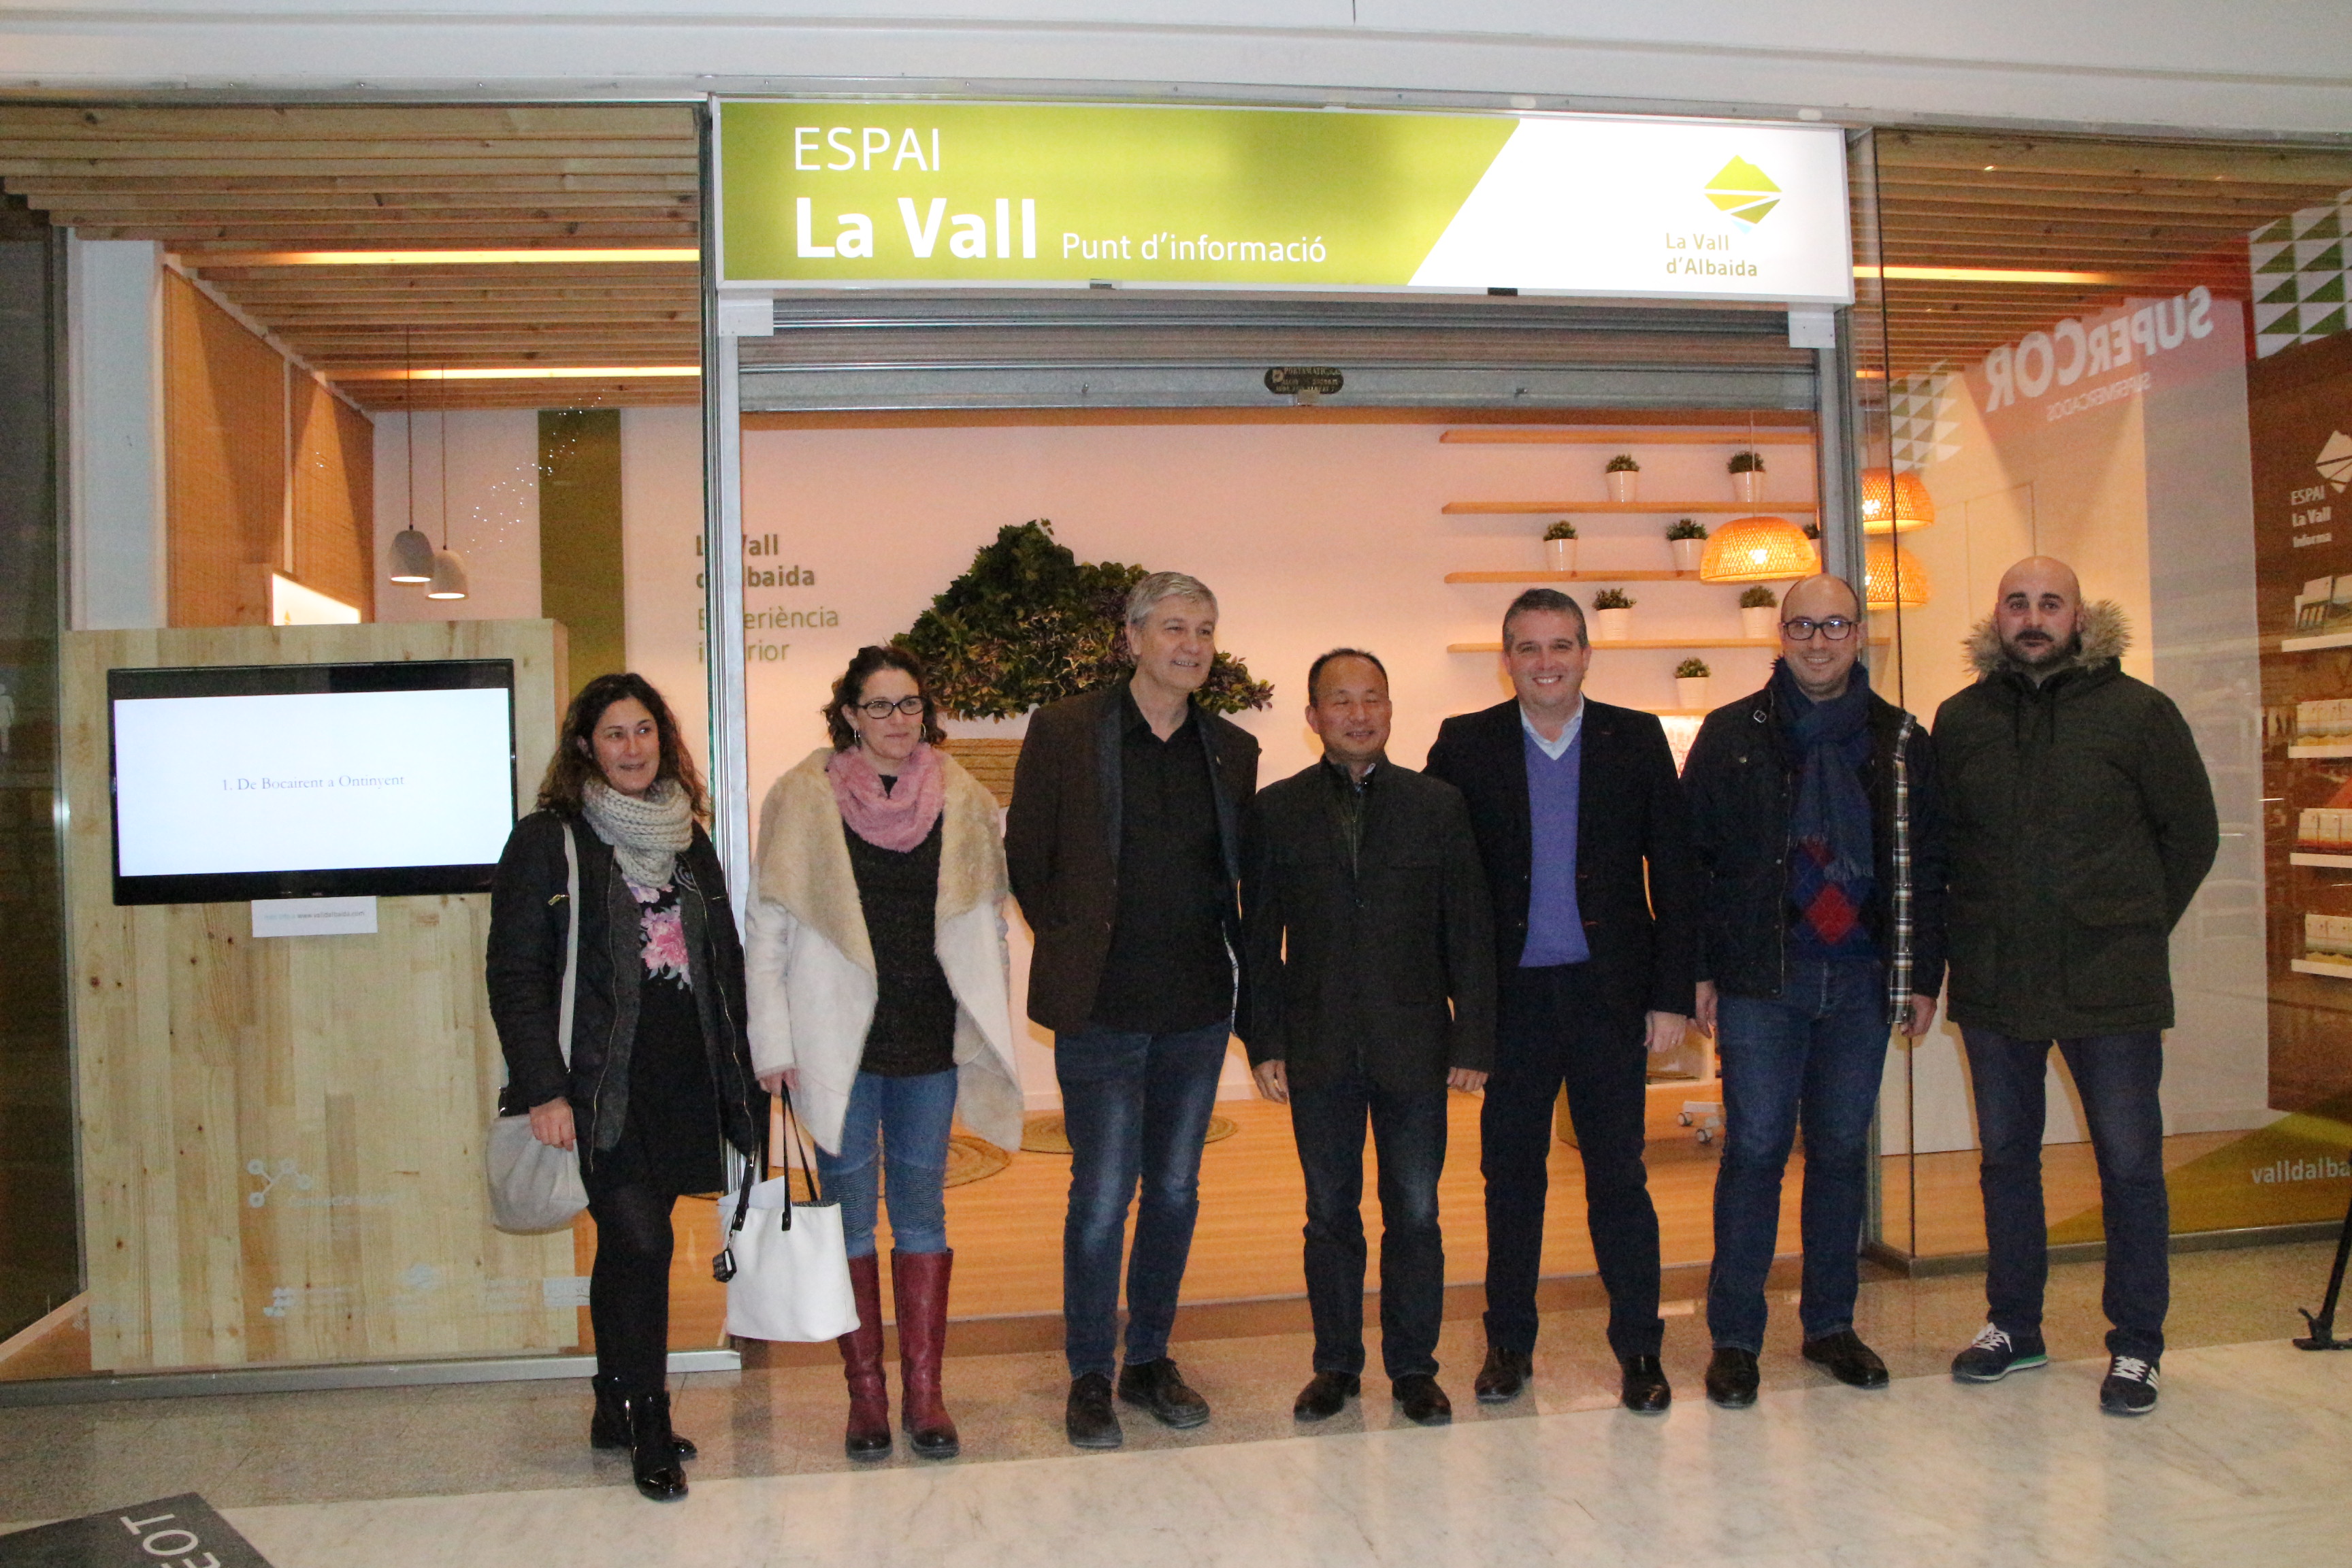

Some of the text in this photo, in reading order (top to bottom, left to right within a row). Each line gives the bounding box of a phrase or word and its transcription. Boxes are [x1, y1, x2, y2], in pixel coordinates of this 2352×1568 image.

[794, 127, 941, 171] ESPAI
[796, 197, 1327, 263] La Vall Punt d'informació
[1665, 233, 1729, 250] La Vall
[1666, 257, 1758, 277] d'Albaida
[2291, 485, 2325, 506] ESPAI
[2292, 506, 2332, 527] La Vall
[223, 774, 405, 791] 1. De Bocairent a Ontinyent
